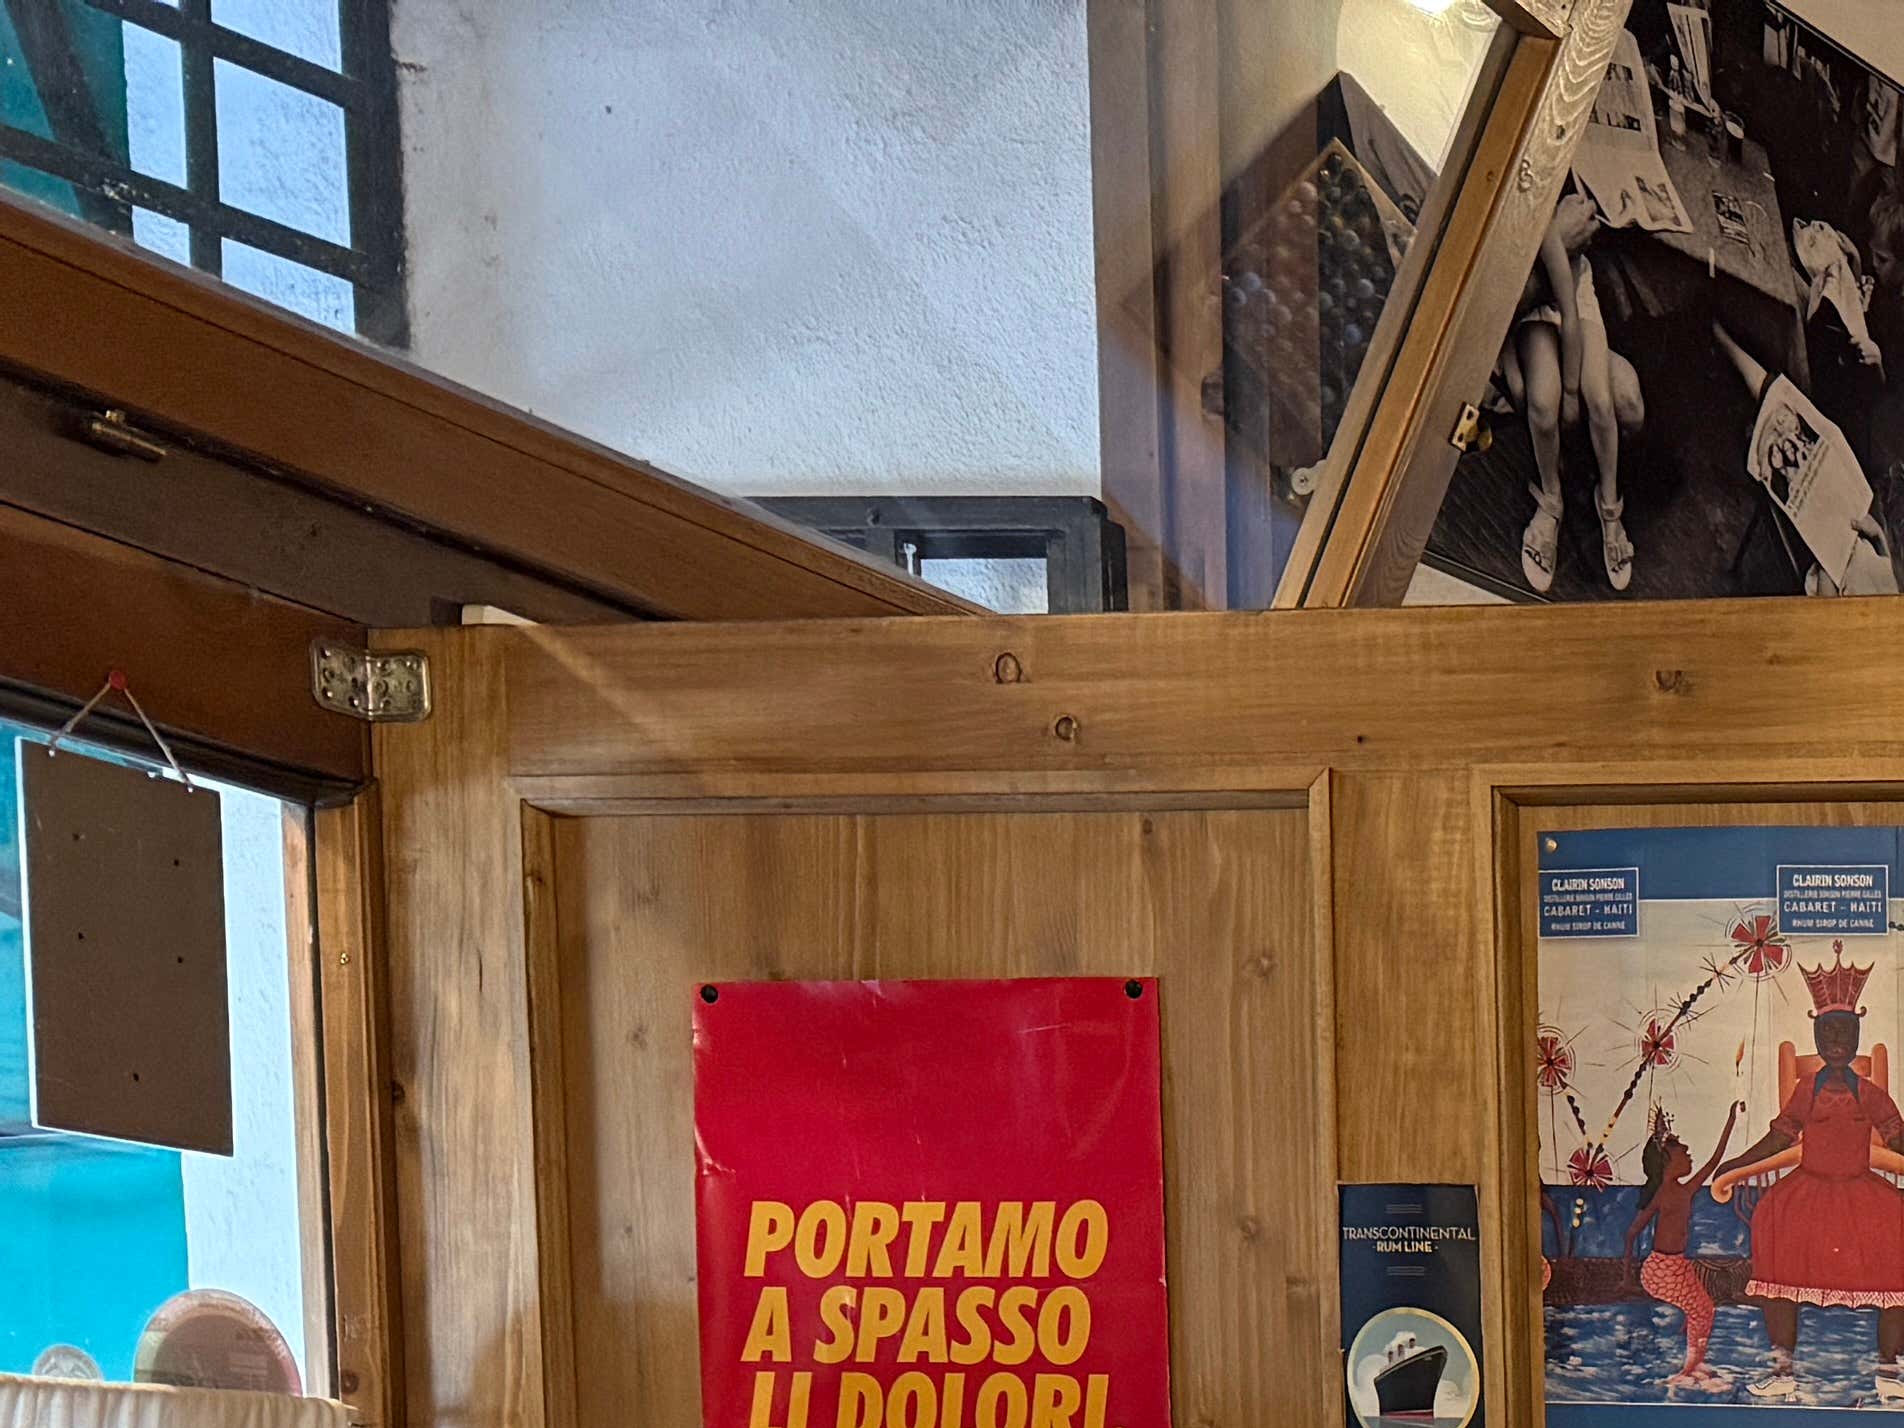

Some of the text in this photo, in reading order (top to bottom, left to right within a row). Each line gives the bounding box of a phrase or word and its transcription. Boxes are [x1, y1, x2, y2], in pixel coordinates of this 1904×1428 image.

[1784, 901, 1836, 912] CABARET
[743, 1199, 1110, 1279] PORTAMO
[1342, 1226, 1477, 1240] TRANSCONTINENTAL
[1376, 1241, 1432, 1252] RUM LINE
[740, 1285, 1093, 1366] A SPASSO
